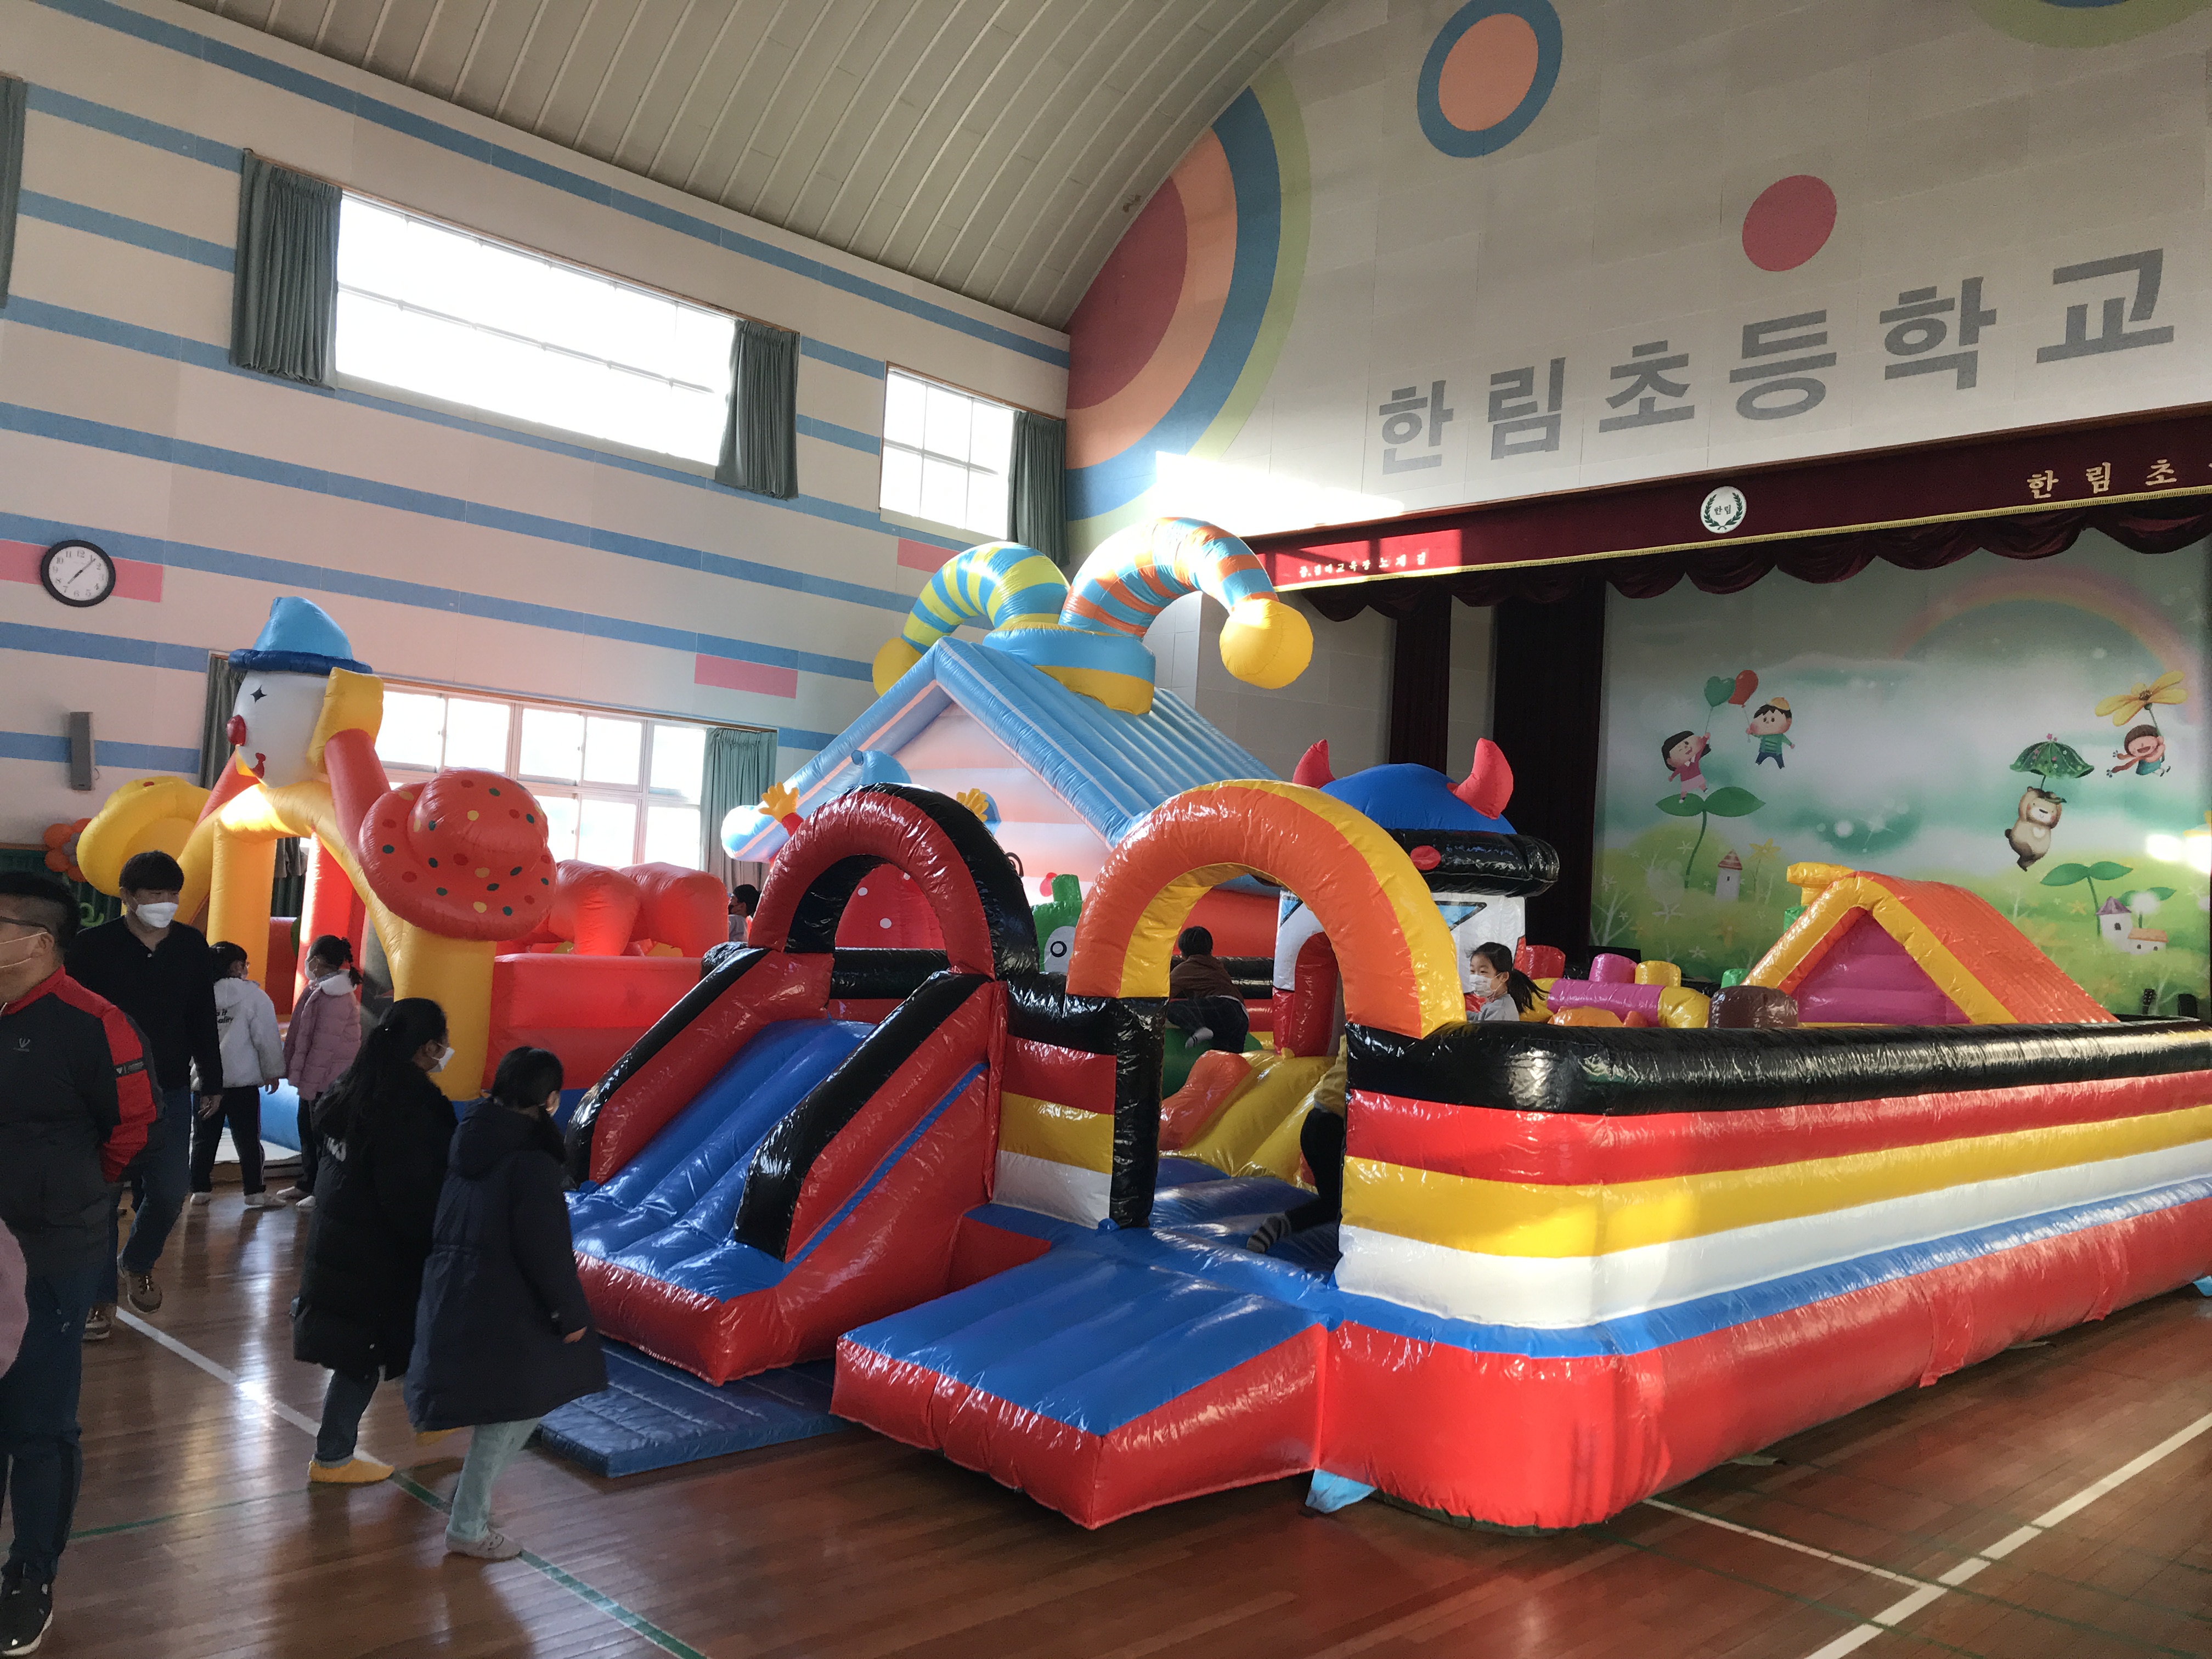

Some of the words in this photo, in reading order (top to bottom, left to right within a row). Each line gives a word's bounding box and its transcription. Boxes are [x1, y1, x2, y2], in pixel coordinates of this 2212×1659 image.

[1378, 247, 2175, 476] 한림초등학교
[2027, 459, 2212, 499] 한림초
[1714, 505, 1731, 515] 한림
